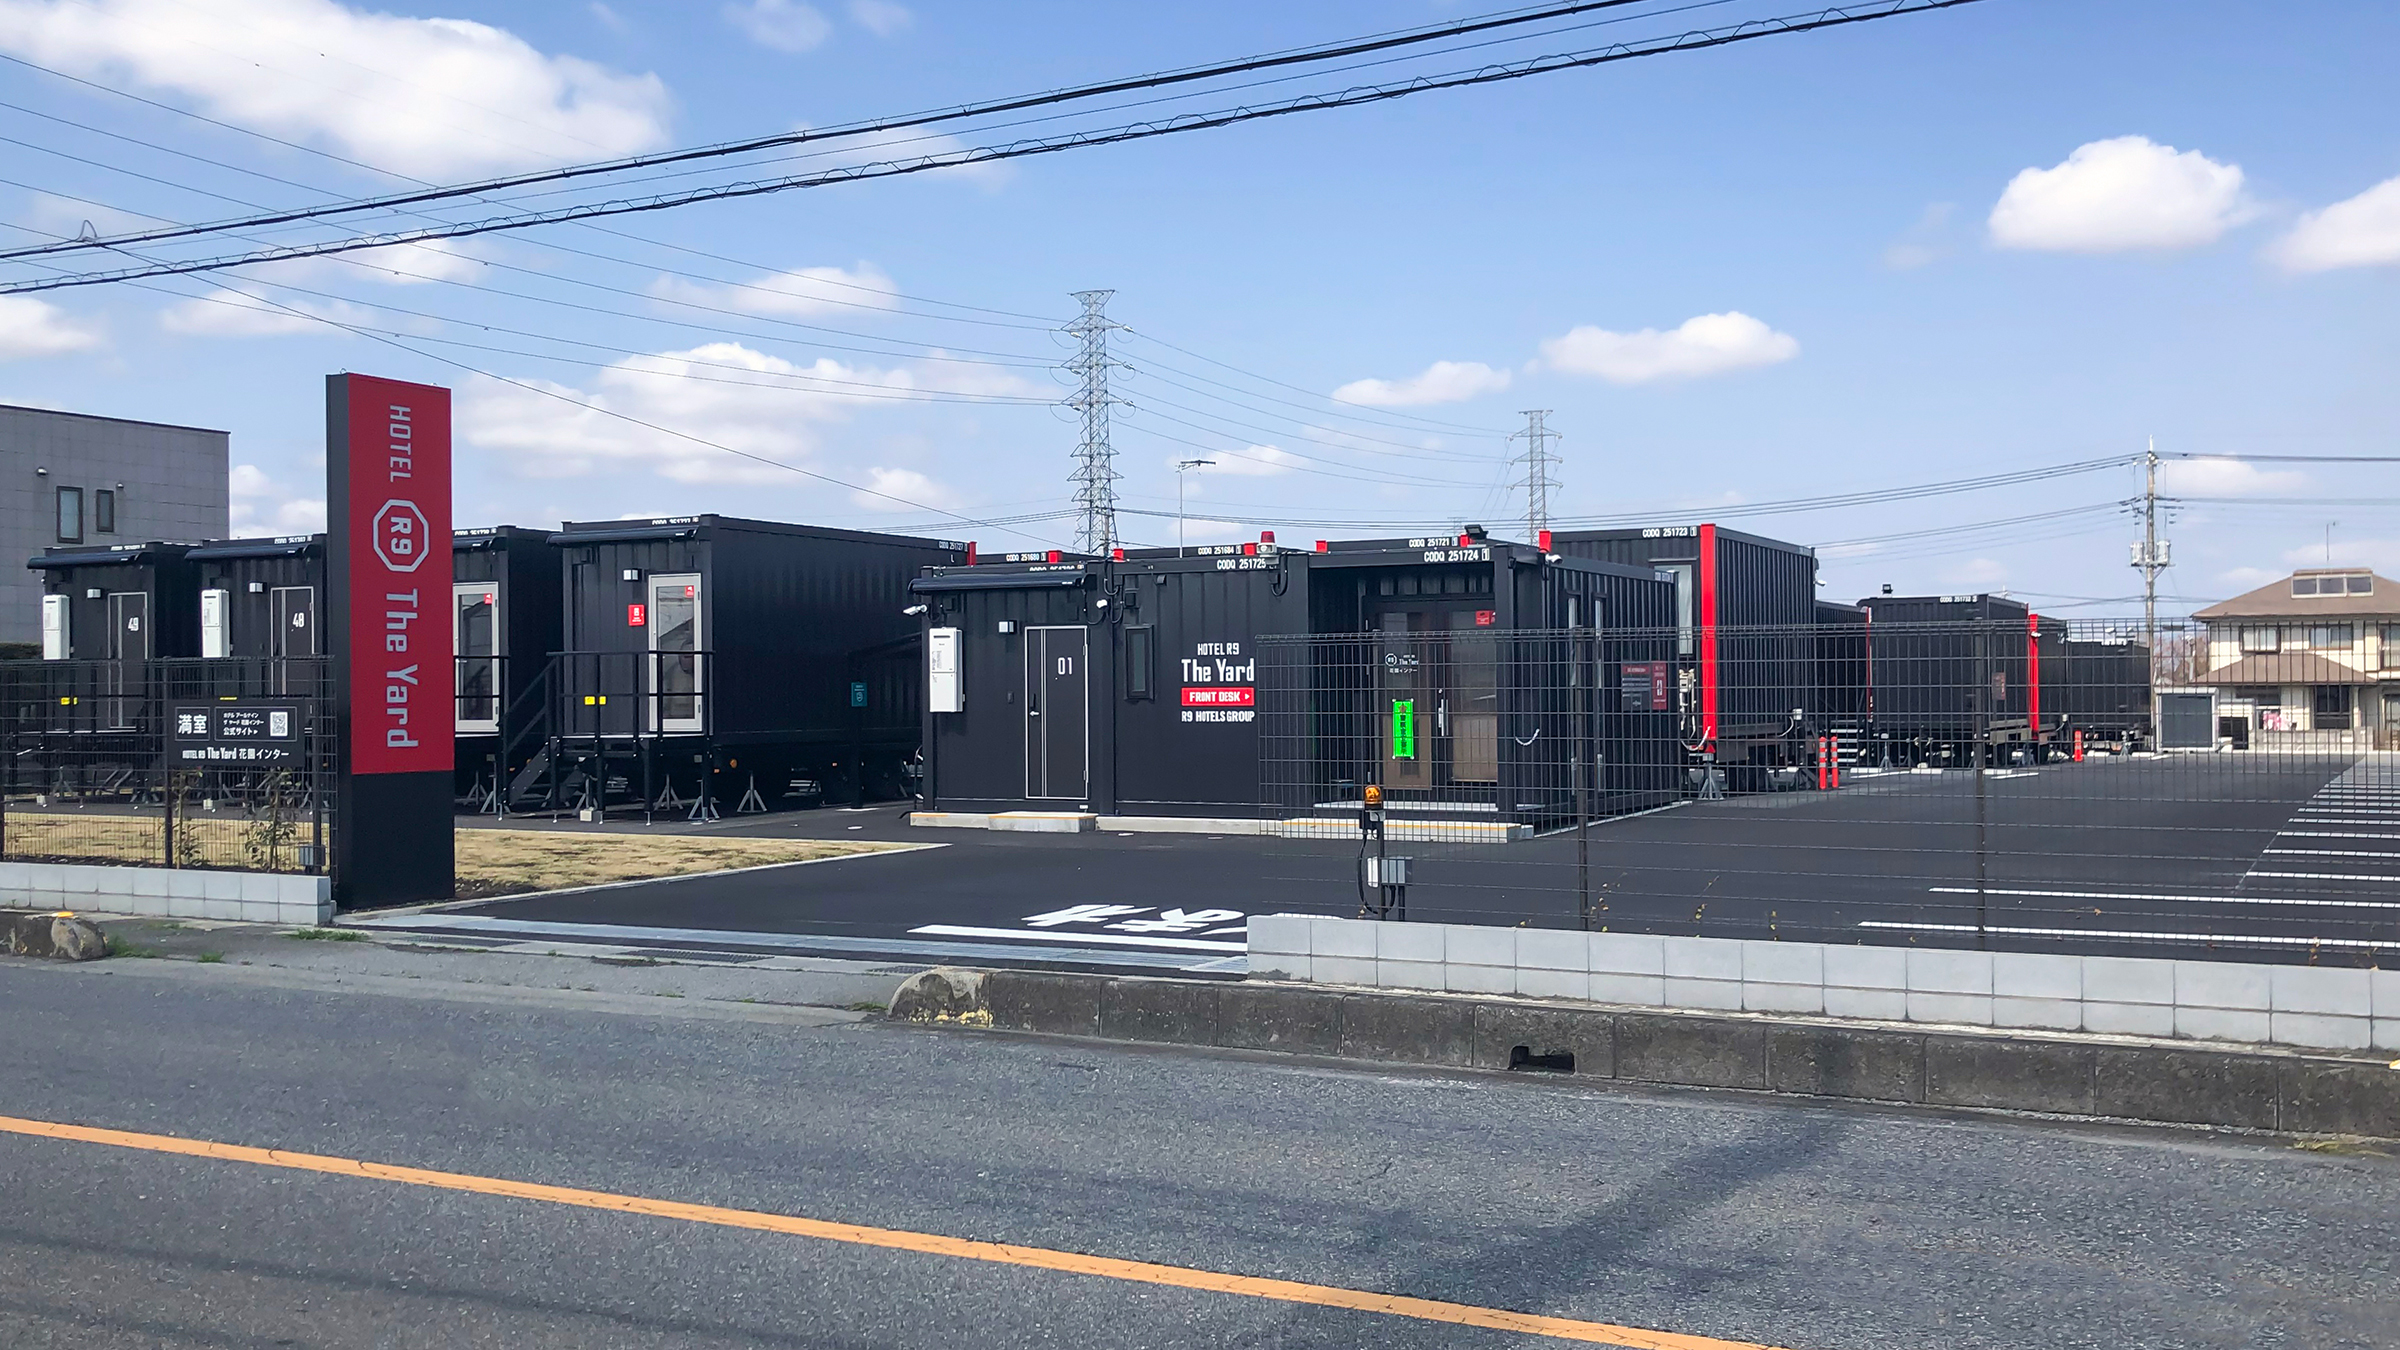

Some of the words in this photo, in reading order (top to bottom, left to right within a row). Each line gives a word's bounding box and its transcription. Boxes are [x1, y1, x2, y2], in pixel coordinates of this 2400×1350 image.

[389, 404, 412, 483] HOTEL
[390, 516, 412, 555] R9
[1662, 526, 1688, 537] 251723
[1427, 537, 1449, 547] 251721
[1424, 551, 1445, 562] CODQ
[1448, 550, 1479, 562] 251724
[1216, 559, 1236, 570] CODQ
[1239, 558, 1267, 570] 251725
[127, 617, 139, 631] 49
[292, 612, 304, 628] 48
[386, 588, 418, 652] The
[1197, 642, 1225, 655] HOTEL
[1226, 642, 1239, 655] R9
[1057, 657, 1073, 675] 01
[1181, 658, 1212, 682] The
[1215, 658, 1255, 682] Yard
[1189, 691, 1217, 702] FRONT
[1218, 691, 1241, 702] DESK
[386, 663, 419, 748] Yard
[1181, 711, 1193, 722] R9
[1195, 711, 1225, 722] HOTELS
[1226, 711, 1255, 722] GROUP
[178, 714, 208, 735] 満室
[223, 727, 252, 736] 公式サイト
[206, 746, 220, 759] The
[220, 746, 237, 759] Yard
